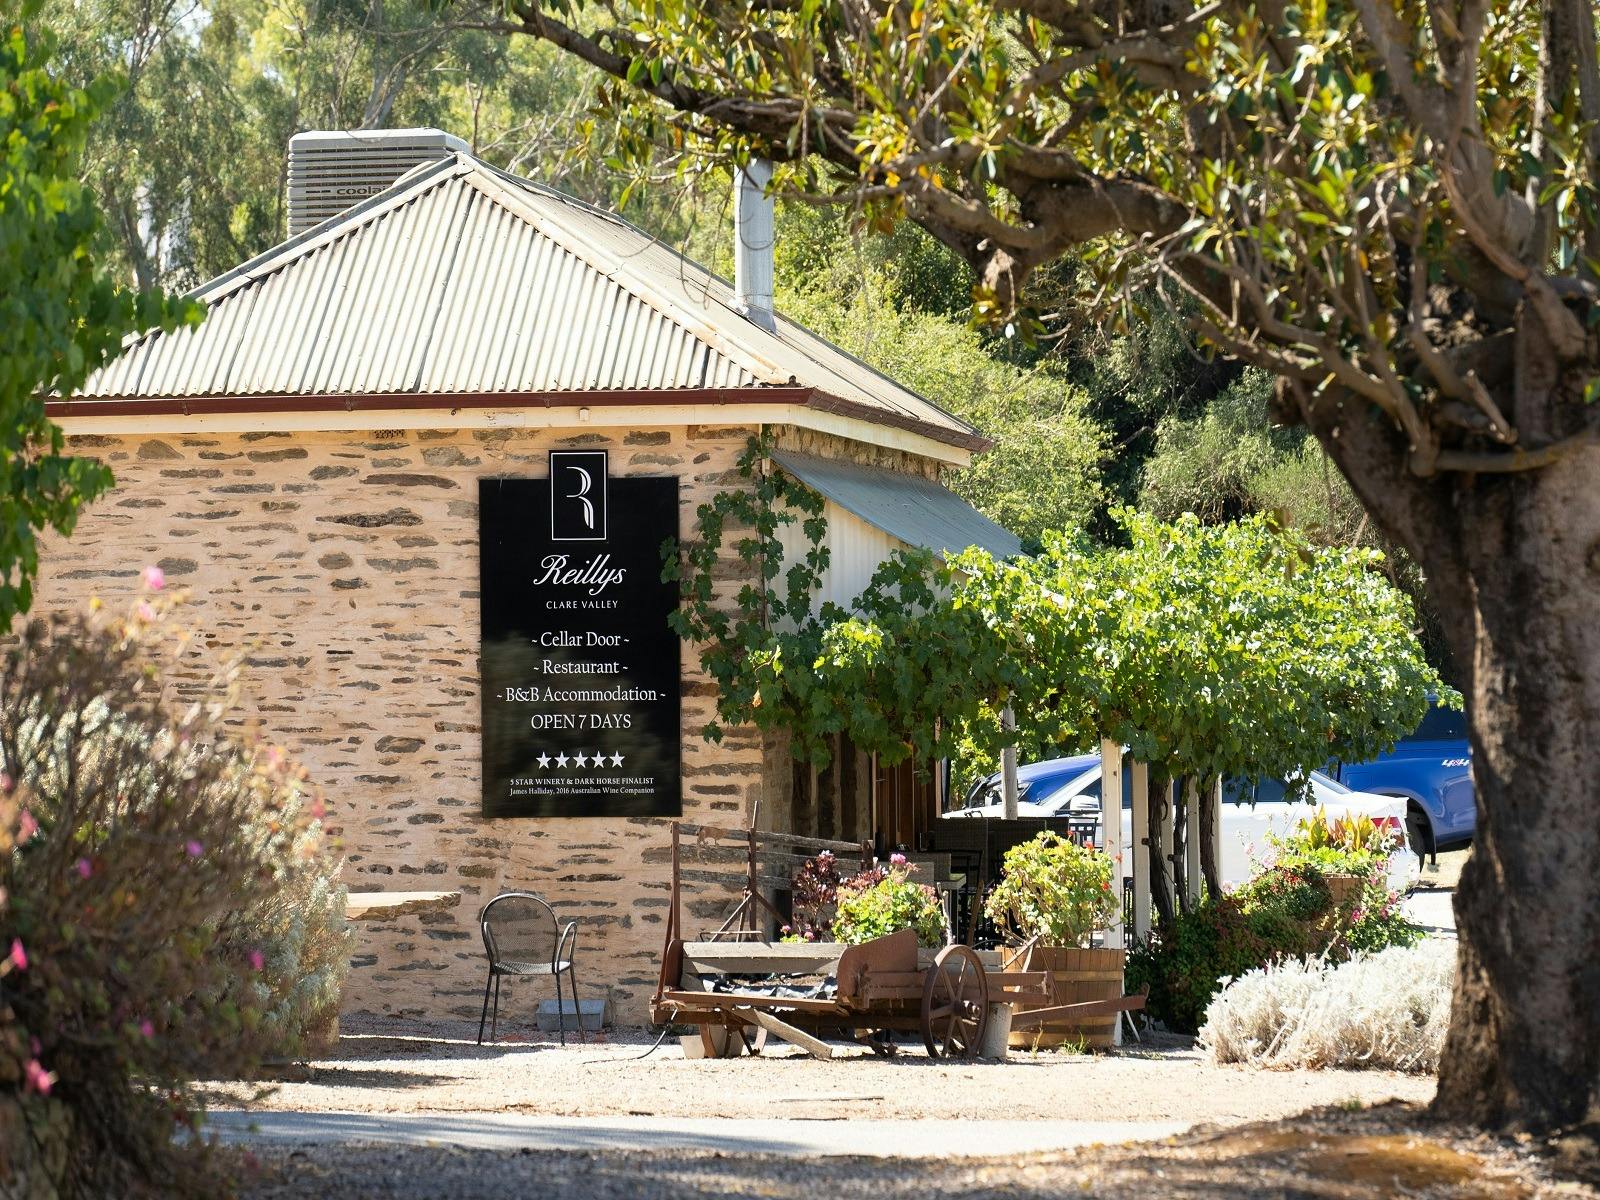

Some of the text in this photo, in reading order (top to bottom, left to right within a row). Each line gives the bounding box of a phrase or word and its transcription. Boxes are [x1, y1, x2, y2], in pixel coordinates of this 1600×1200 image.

[533, 554, 627, 596] Reillys
[546, 600, 618, 609] CLARE VALLEY
[540, 631, 621, 647] Cellar Door
[542, 659, 620, 674] Restaurant
[505, 685, 658, 702] B&B Accommodation
[531, 713, 632, 730] OPEN 7 DAYS
[510, 778, 515, 786] 5
[515, 778, 534, 786] STAR
[574, 777, 595, 785] DARK
[596, 777, 620, 785] HORSE
[621, 777, 654, 785] FINALIST
[509, 788, 528, 797] James
[620, 786, 655, 796] Companion
